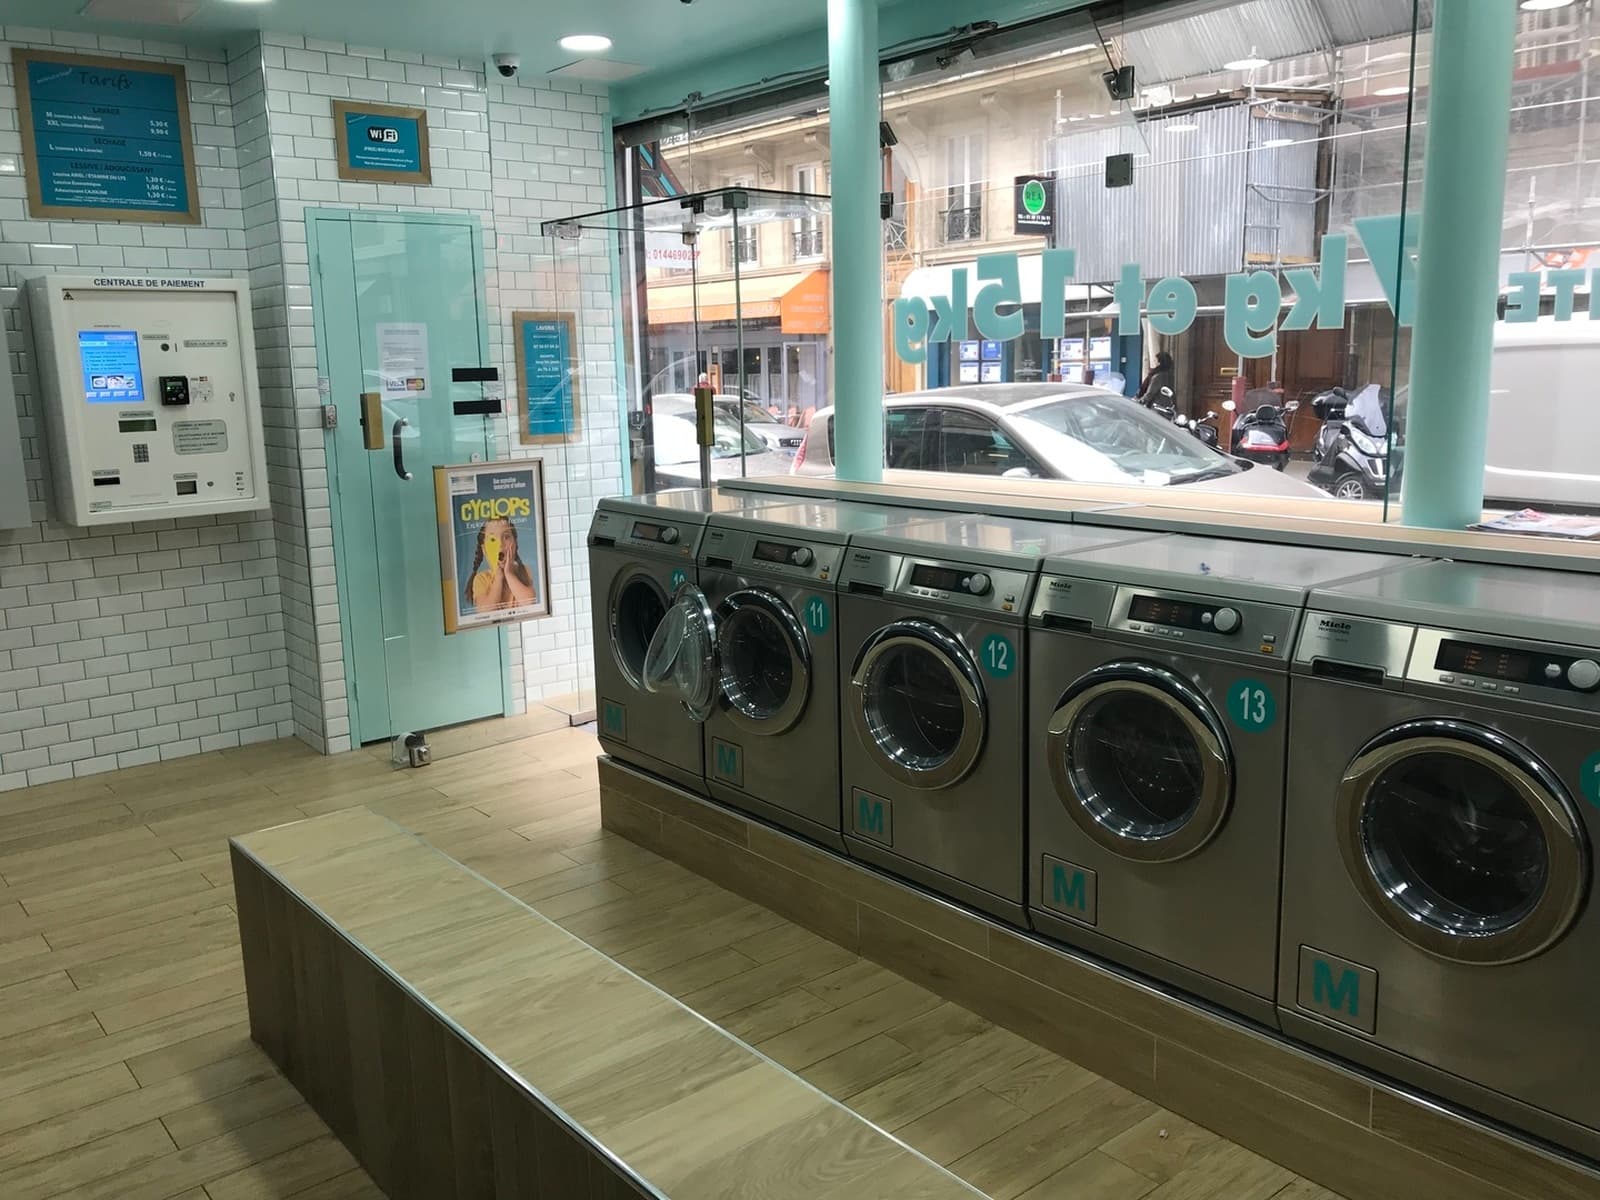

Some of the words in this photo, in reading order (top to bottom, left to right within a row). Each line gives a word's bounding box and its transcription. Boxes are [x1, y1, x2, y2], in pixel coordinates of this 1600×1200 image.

[79, 71, 133, 91] Tarifs
[93, 278, 144, 287] CENTRALE
[145, 279, 159, 288] DE
[160, 280, 205, 288] PAIEMENT
[460, 497, 531, 521] CYCLOPS
[809, 601, 824, 628] 11
[1319, 619, 1352, 630] Miele
[988, 640, 1008, 670] 12
[605, 702, 623, 733] M
[1239, 687, 1266, 724] 13
[717, 742, 737, 777] M
[859, 796, 884, 835] M
[1053, 864, 1086, 911] M
[1313, 958, 1361, 1017] M
